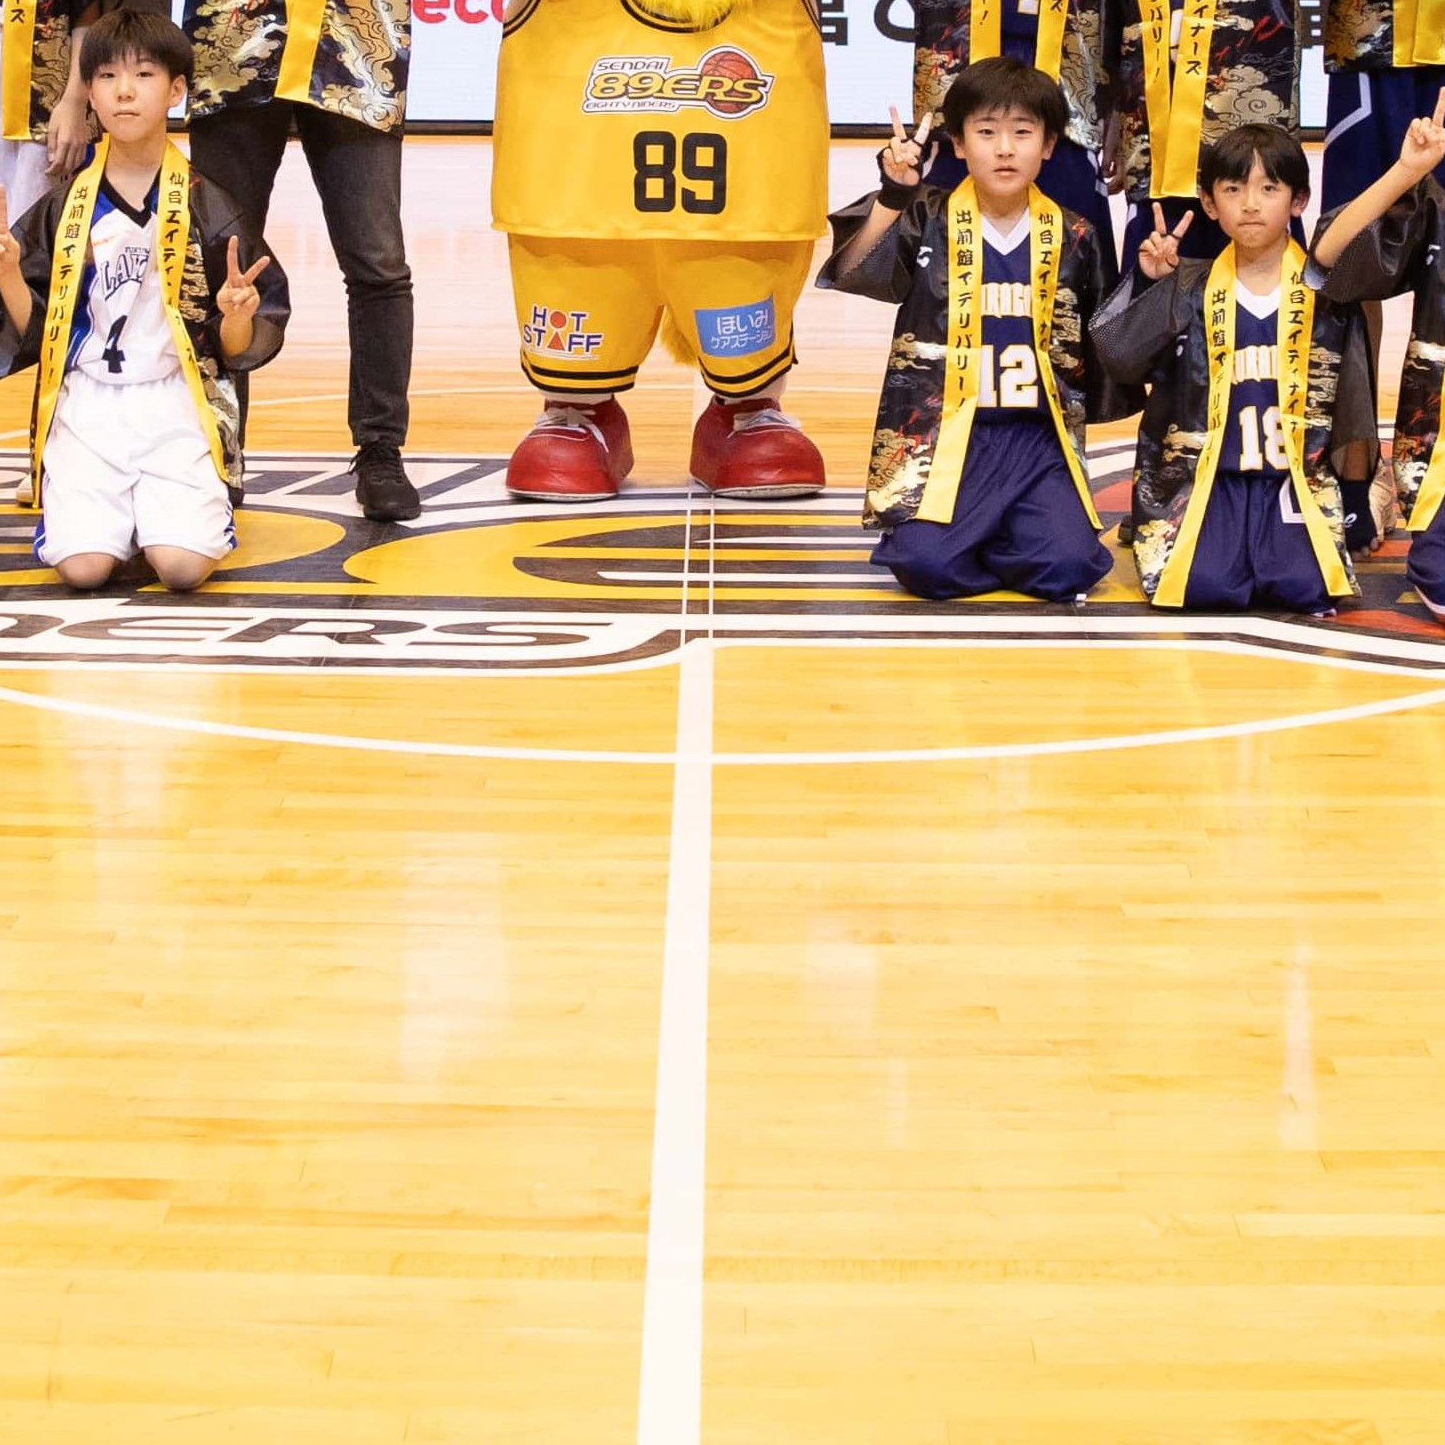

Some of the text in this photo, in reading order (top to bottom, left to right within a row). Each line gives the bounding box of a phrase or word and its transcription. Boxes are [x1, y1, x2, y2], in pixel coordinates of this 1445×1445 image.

[597, 61, 666, 72] SENDAI
[590, 72, 768, 103] 89ERS
[633, 131, 727, 215] 89
[716, 310, 771, 334] ほいみ
[977, 345, 1038, 408] 12
